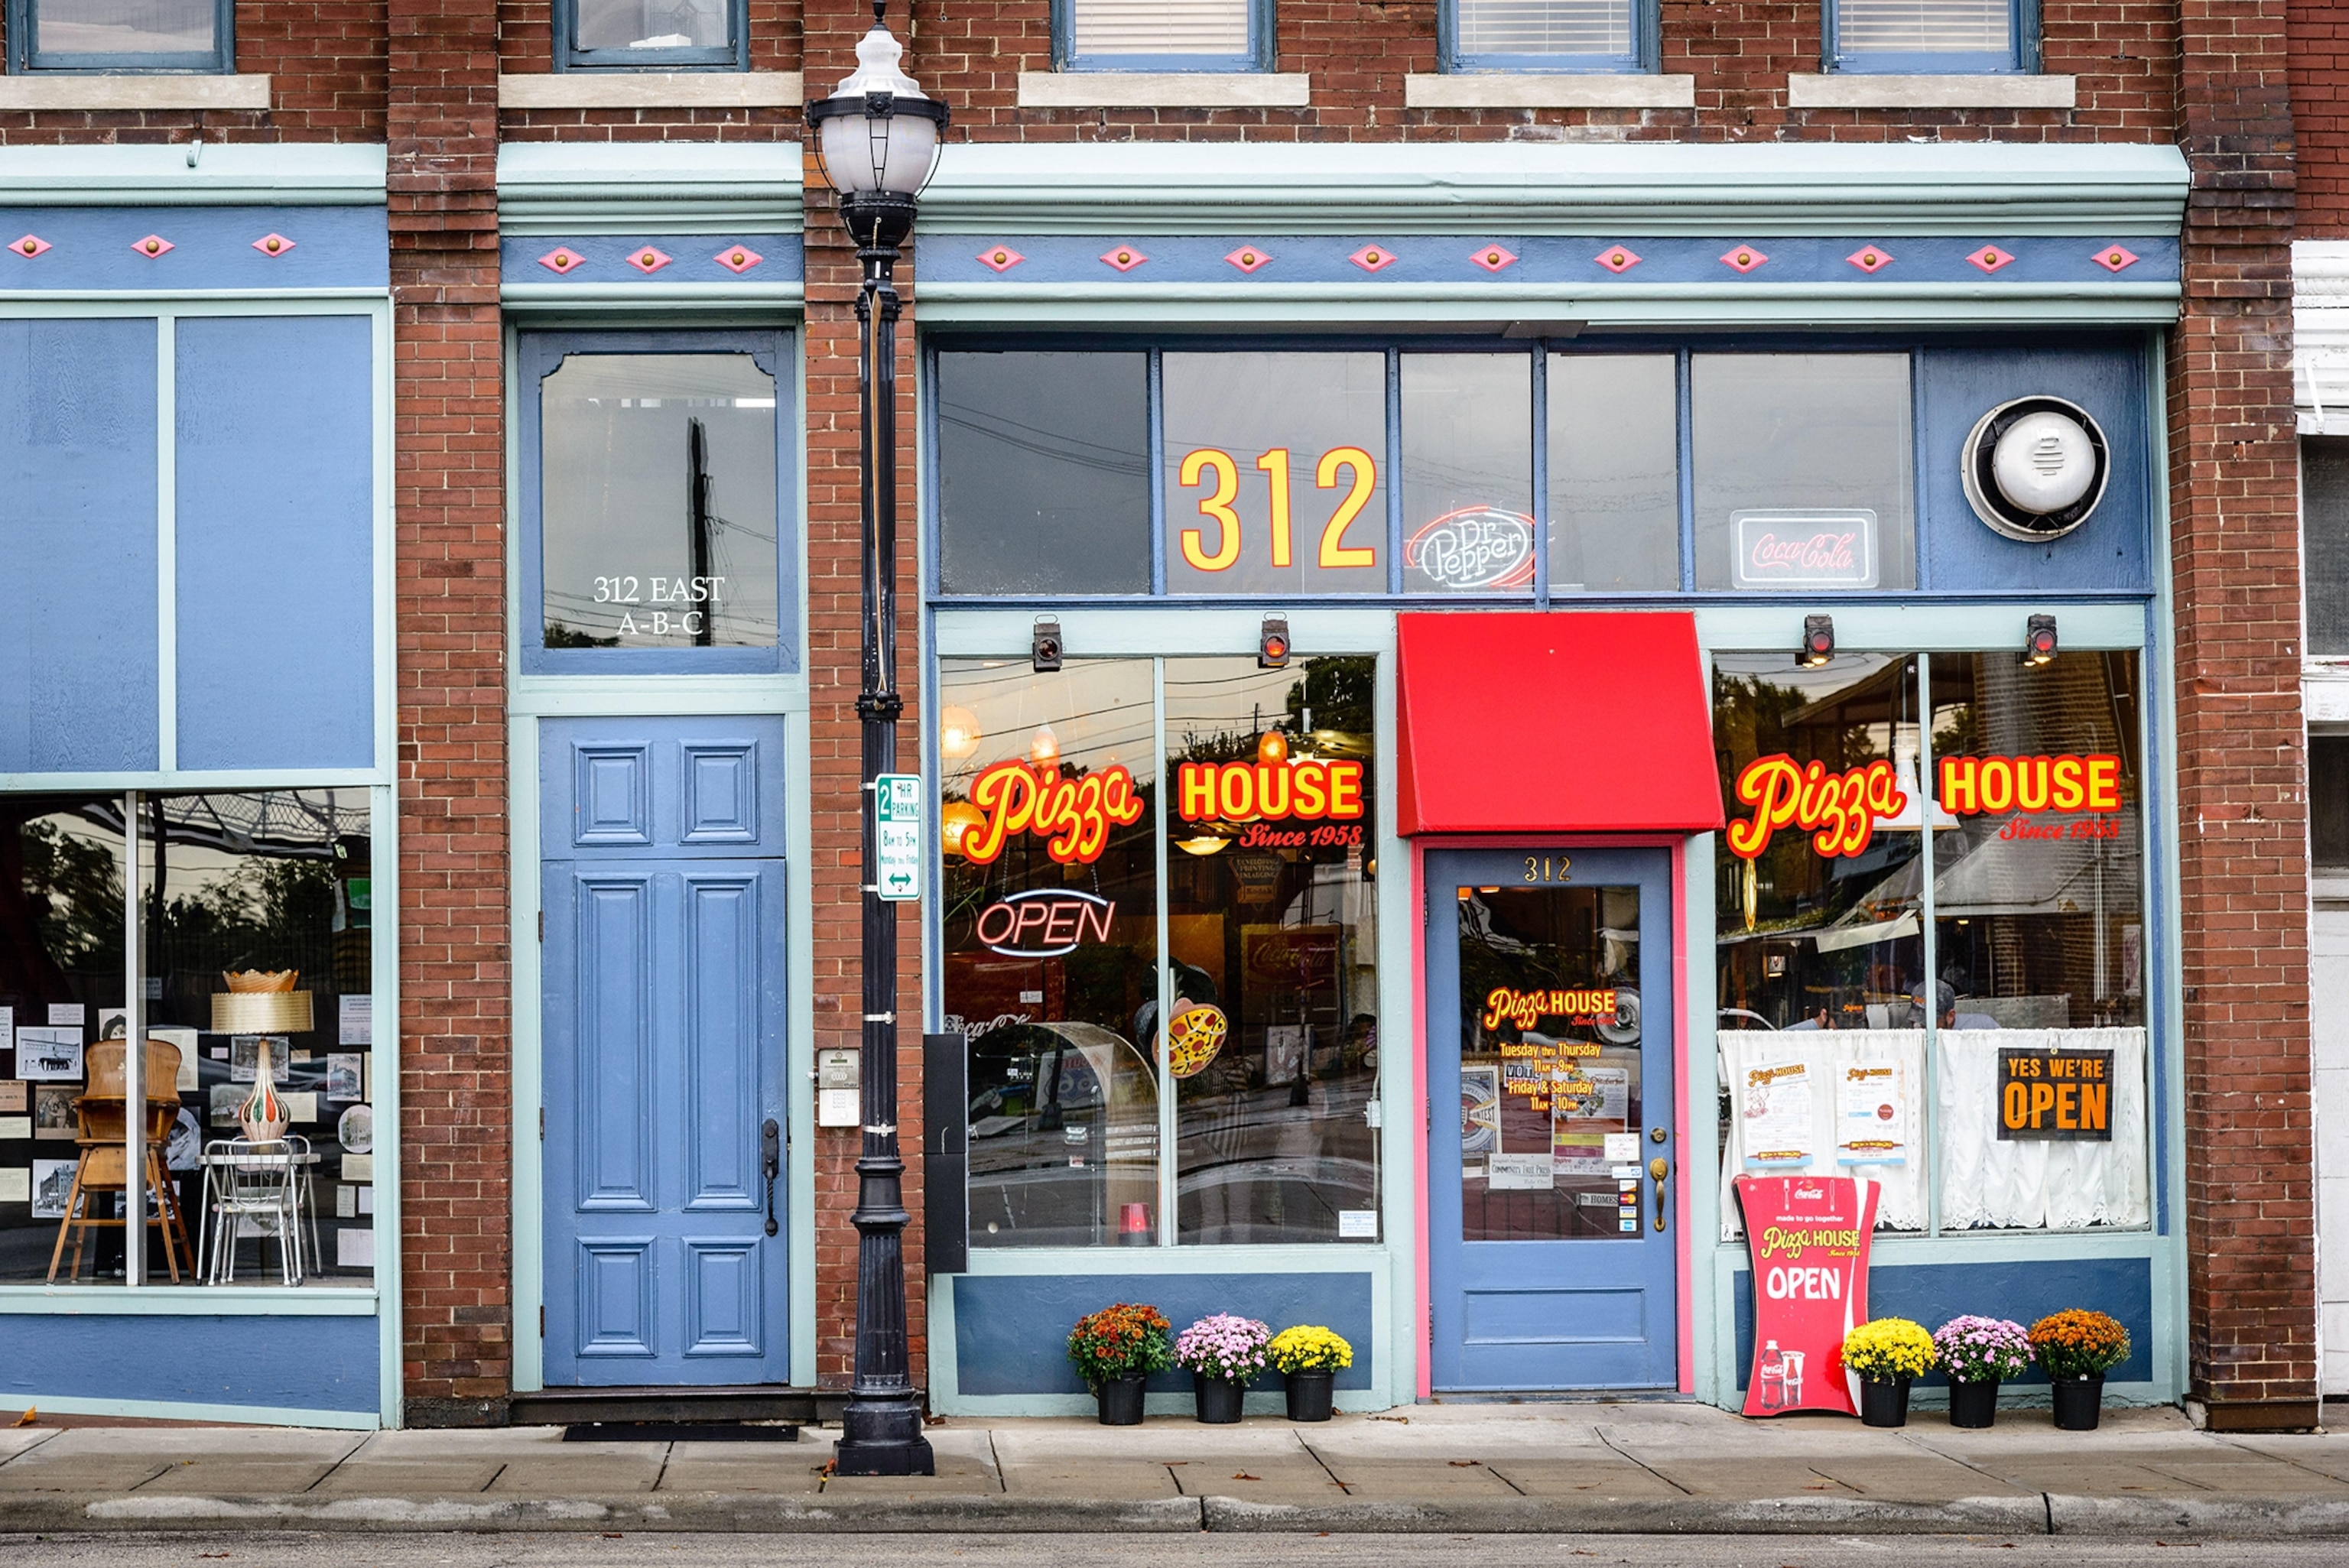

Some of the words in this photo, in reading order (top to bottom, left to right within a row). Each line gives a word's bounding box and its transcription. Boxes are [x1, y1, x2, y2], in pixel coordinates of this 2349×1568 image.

[1178, 446, 1377, 573] 312
[1455, 520, 1496, 551] Dr
[1421, 529, 1522, 581] Pepper
[1752, 532, 1857, 570] Coca-Cola
[593, 576, 640, 603] 312
[649, 576, 726, 603] EAST
[616, 610, 704, 635] A-B-C
[879, 784, 891, 816] 2
[900, 784, 912, 798] HR
[892, 803, 919, 817] PARKING
[960, 758, 1145, 865] Pizza
[1178, 760, 1363, 822] HOUSE
[1727, 753, 1907, 859] Pizza
[1938, 755, 2122, 815] HOUSE
[1239, 823, 1306, 848] Since
[1310, 824, 1363, 846] 1958
[2000, 818, 2065, 841] Since
[2068, 819, 2120, 839] 1958
[1524, 855, 1571, 882] 312
[976, 901, 1116, 945] OPEN
[1483, 986, 1549, 1031] Pizza
[1549, 989, 1616, 1014] HOUSE
[1571, 1015, 1596, 1026] Since
[1499, 1042, 1539, 1058] Tuesday
[1541, 1047, 1556, 1056] thru
[1557, 1041, 1602, 1058] Thursday
[1775, 1063, 1805, 1076] HOUSE
[2008, 1058, 2042, 1077] YES
[2048, 1059, 2104, 1078] WE'RE
[1508, 1080, 1538, 1096] Friday
[1540, 1080, 1549, 1094] &
[1550, 1079, 1594, 1096] Saturday
[2003, 1081, 2107, 1130] OPEN
[1815, 1215, 1844, 1223] together
[1760, 1226, 1812, 1258] Pizza
[1812, 1229, 1860, 1247] HOUSE
[1766, 1266, 1841, 1300] OPEN
